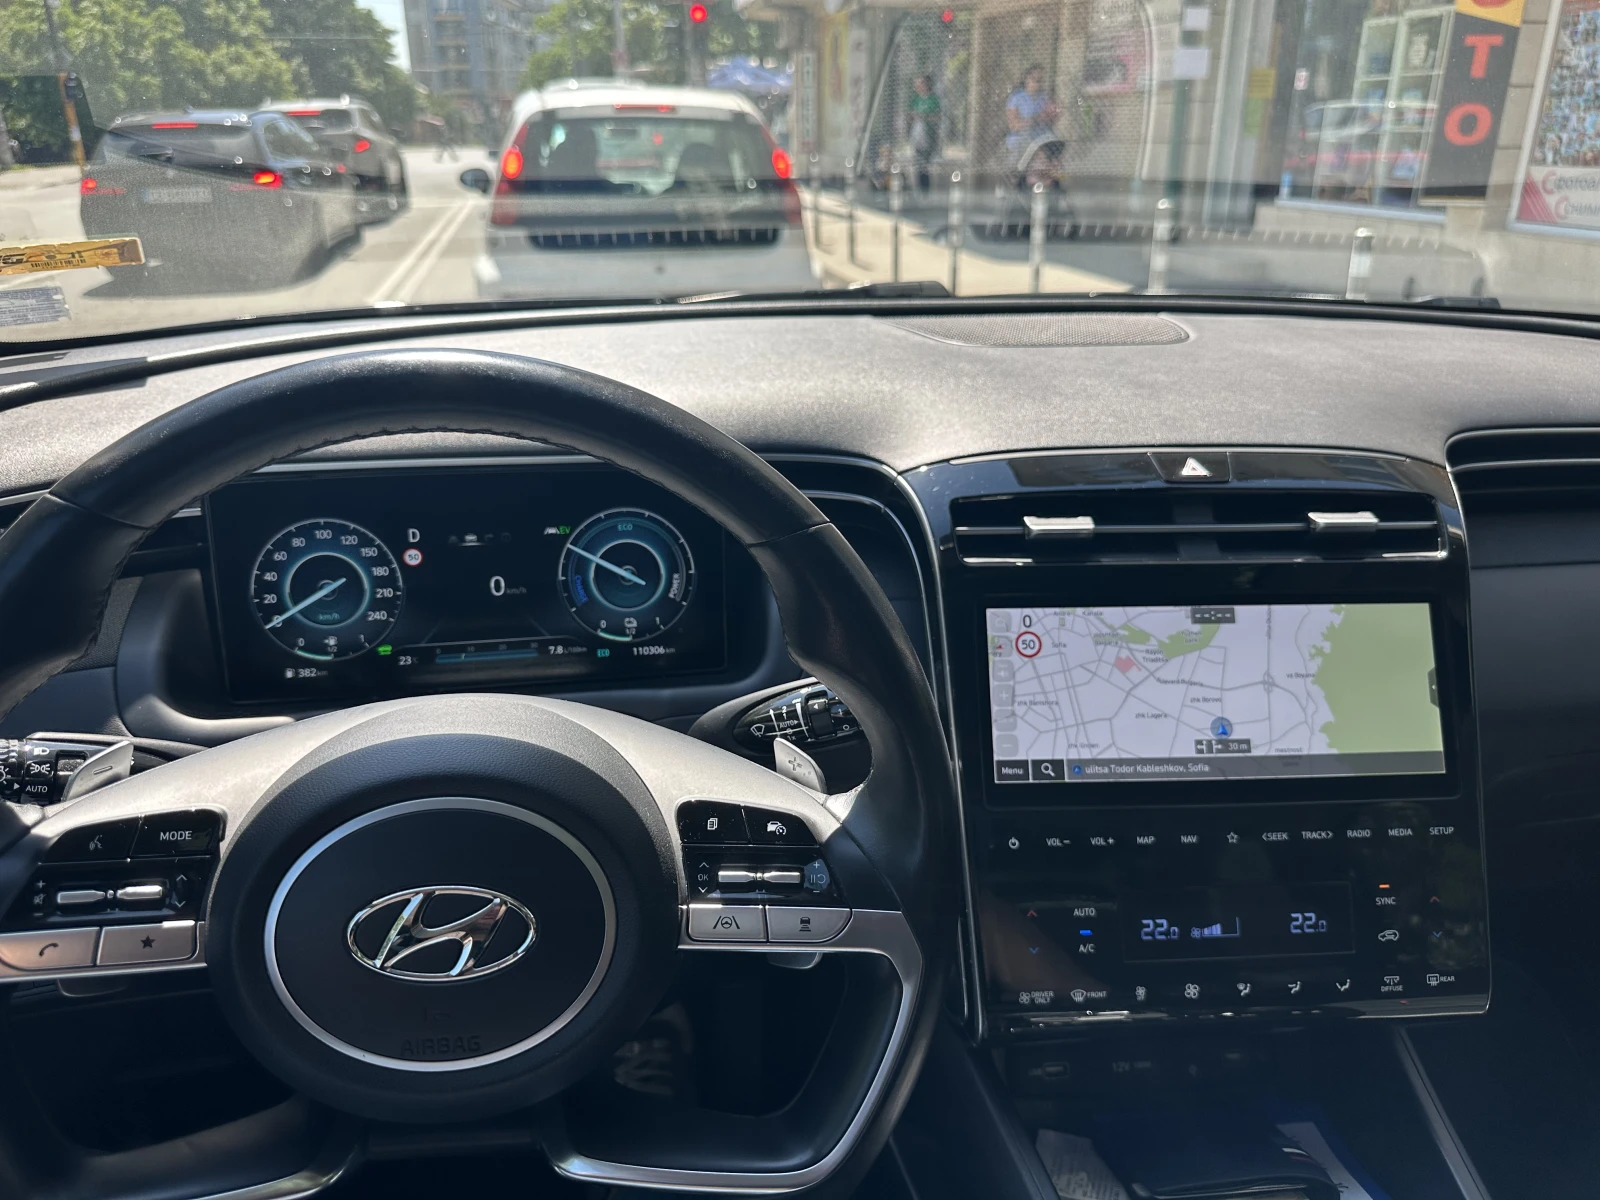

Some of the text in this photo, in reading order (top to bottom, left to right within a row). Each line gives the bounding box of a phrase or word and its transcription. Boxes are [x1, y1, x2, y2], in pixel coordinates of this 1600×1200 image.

[315, 530, 333, 540] 100
[408, 528, 420, 543] D
[559, 526, 571, 535] EV
[292, 537, 306, 547] 80
[340, 535, 358, 546] 120
[273, 551, 288, 562] 60
[360, 547, 378, 557] 150
[408, 553, 420, 562] 50
[372, 566, 389, 577] 180
[263, 572, 278, 582] 40
[489, 575, 506, 597] 0
[668, 573, 681, 599] POWER
[376, 588, 394, 598] 210
[263, 594, 278, 604] 20
[367, 611, 388, 621] 240
[1022, 614, 1032, 628] 0
[600, 620, 607, 629] 0
[298, 637, 305, 647] 0
[1021, 639, 1036, 650] 50
[633, 646, 665, 655] 110306
[780, 719, 794, 729] AUTO
[1228, 742, 1239, 751] 30
[1001, 766, 1024, 775] Menu
[1085, 764, 1109, 774] ulitsa
[1110, 764, 1134, 773] Todor
[1187, 763, 1210, 772] Sofia
[26, 785, 48, 793] AUTO
[160, 830, 193, 841] MODE
[1347, 829, 1371, 838] RADIO
[1388, 828, 1413, 837] MEDIA
[1429, 826, 1454, 835] SETUP
[1137, 836, 1155, 844] MAP
[1180, 835, 1198, 844] NAV
[698, 873, 709, 881] OK
[1375, 896, 1396, 905] SYNC
[1073, 908, 1096, 917] AUTO
[1290, 912, 1327, 933] 22.0
[1140, 919, 1179, 941] 22.0
[1078, 943, 1096, 953] A/C
[401, 1035, 481, 1057] AIRBAG
